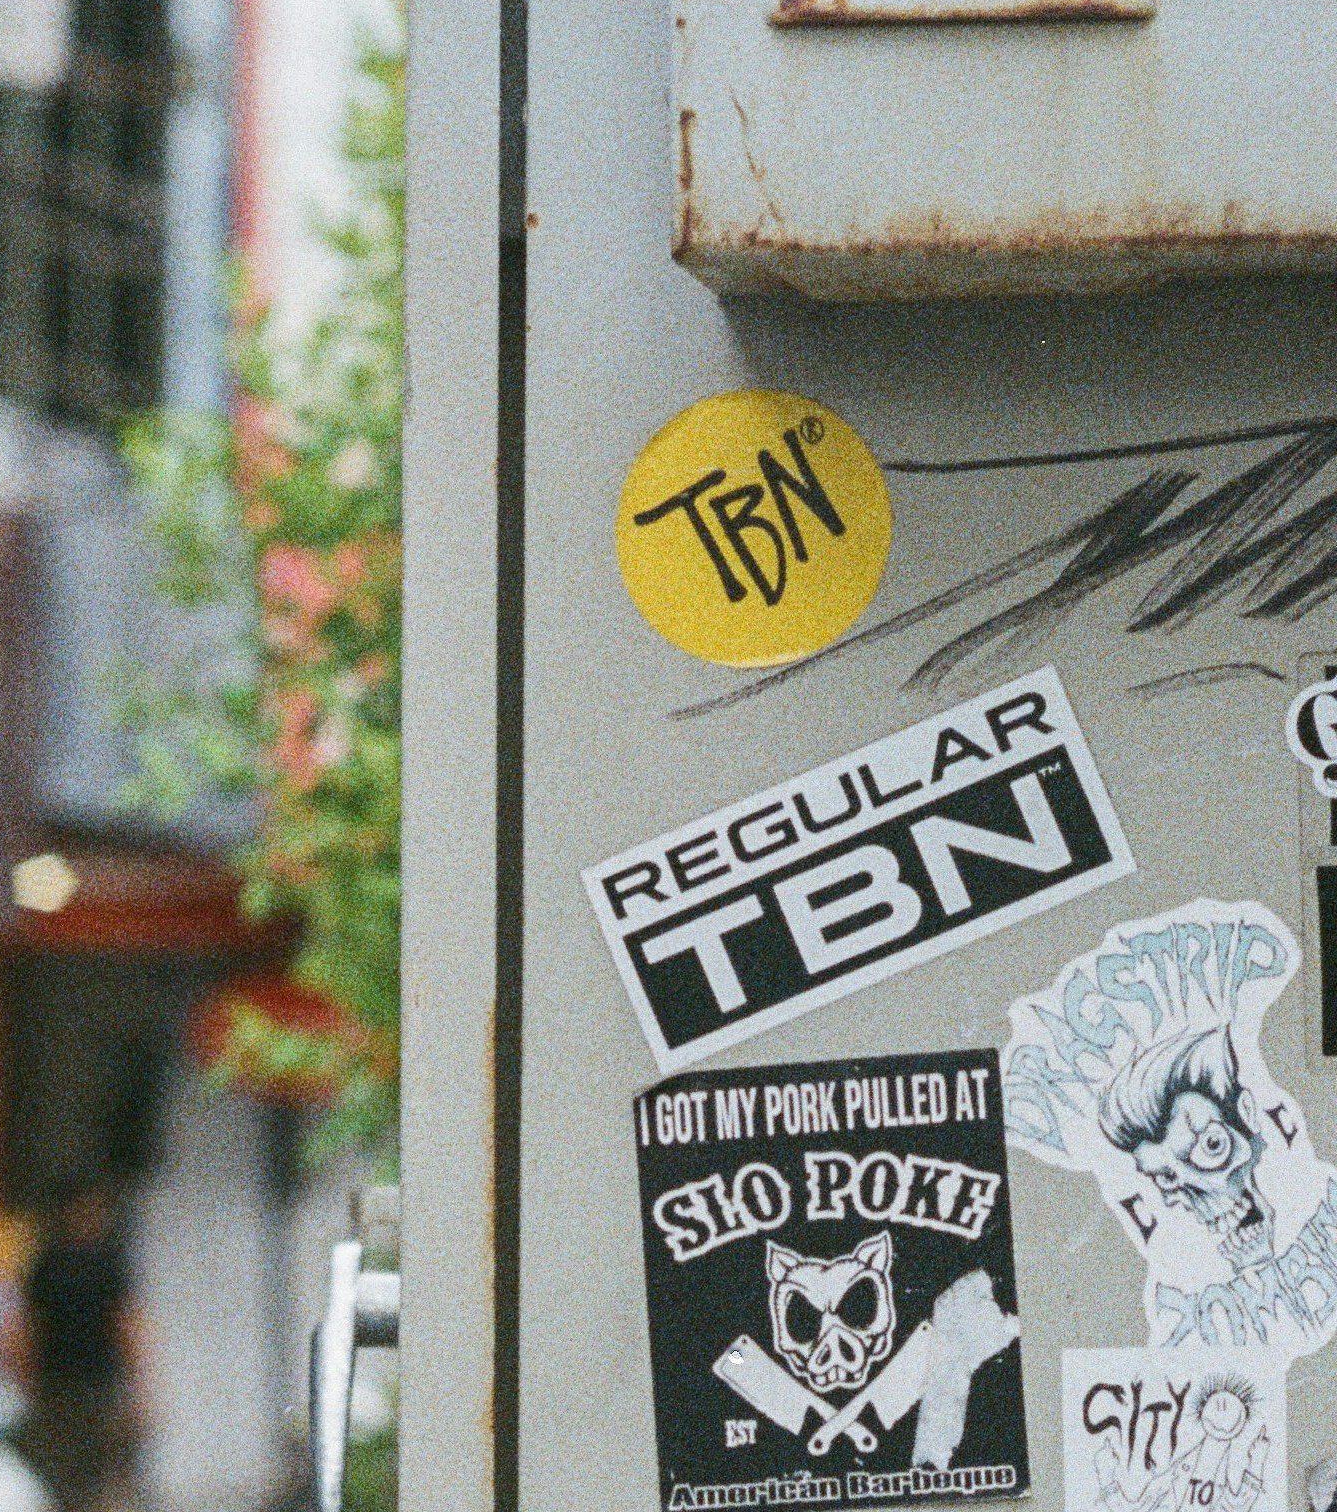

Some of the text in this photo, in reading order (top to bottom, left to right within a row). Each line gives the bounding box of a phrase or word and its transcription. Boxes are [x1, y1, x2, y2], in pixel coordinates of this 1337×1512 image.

[601, 691, 1056, 921] REGULAR
[639, 1068, 990, 1147] I GOT MY PORK PULLED AT
[652, 1149, 1002, 1263] SLO POKE
[724, 1418, 759, 1449] EST
[1082, 1375, 1192, 1472] CITY
[668, 1474, 842, 1512] American
[1187, 1478, 1215, 1506] TO
